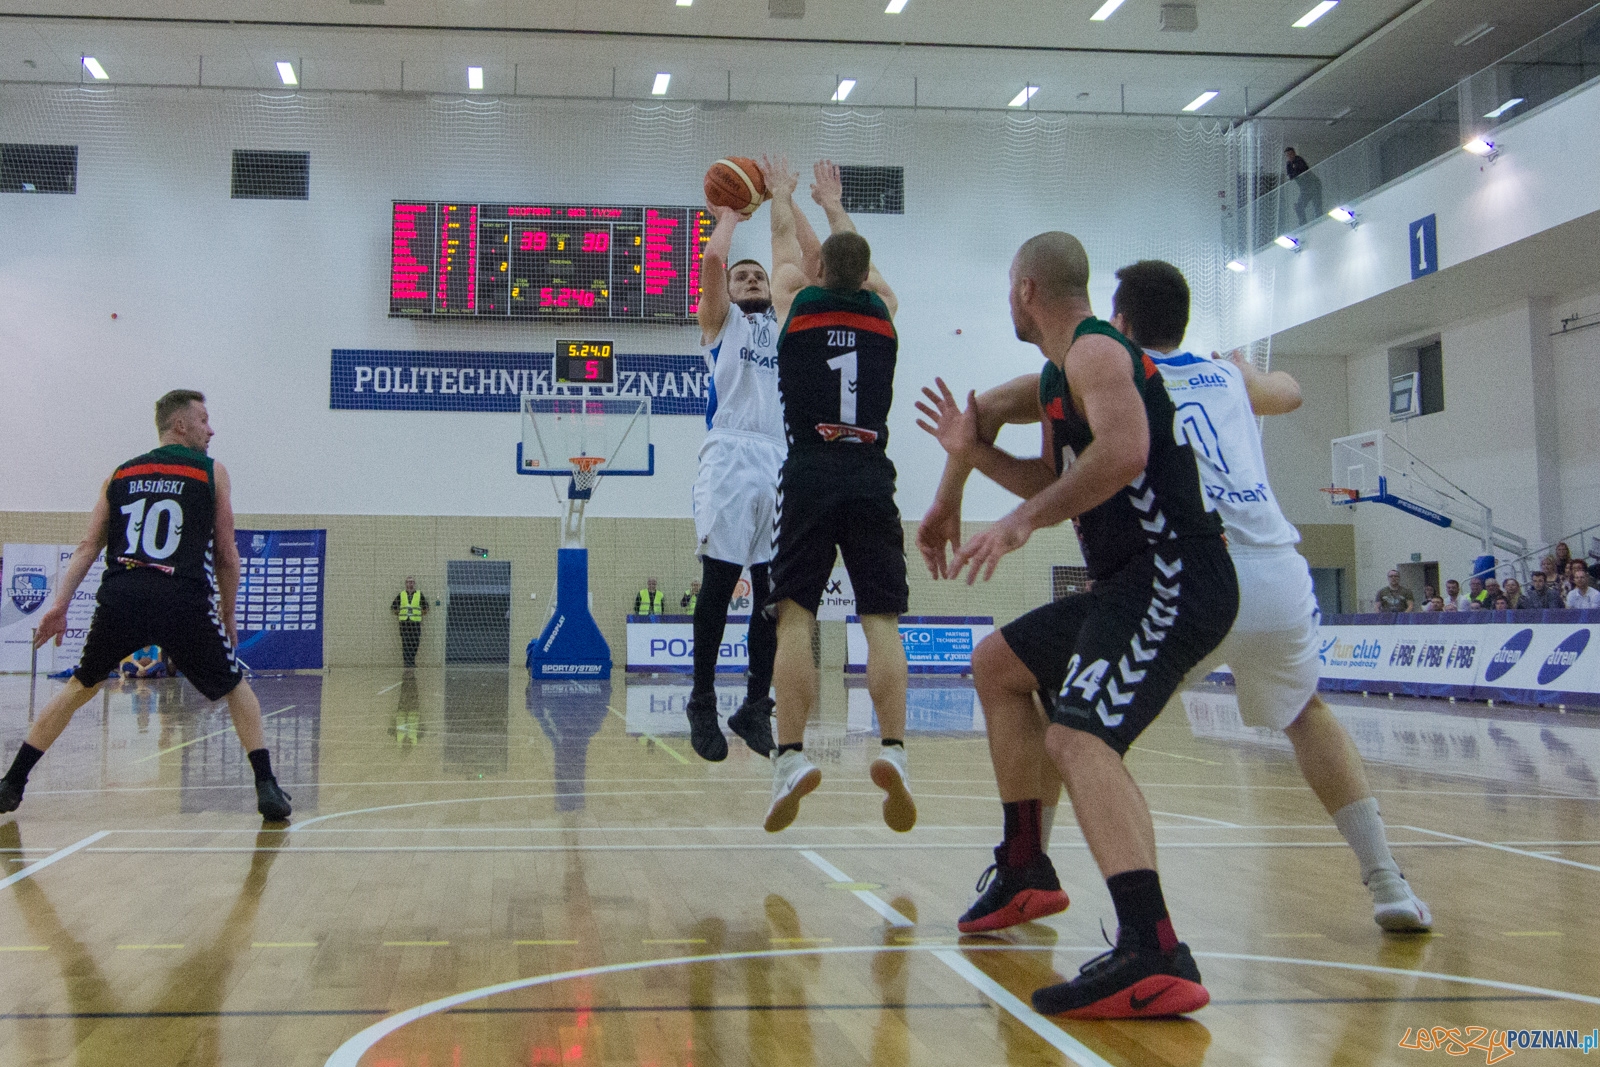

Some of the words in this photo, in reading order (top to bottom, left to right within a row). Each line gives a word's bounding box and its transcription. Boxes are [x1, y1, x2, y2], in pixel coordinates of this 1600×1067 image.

[520, 231, 548, 251] 39
[557, 241, 565, 250] 3
[581, 232, 609, 252] 30
[634, 236, 641, 246] 3
[1416, 225, 1427, 271] 1
[500, 262, 508, 271] 2
[633, 264, 641, 273] 4
[511, 287, 520, 297] 2
[601, 289, 609, 298] 4
[827, 330, 856, 347] ZUB
[585, 361, 599, 379] 5
[826, 350, 858, 425] 1
[129, 478, 185, 494] BASIŃSKI
[120, 498, 183, 560] 10
[8, 588, 50, 597] BASKET
[543, 615, 565, 652] HYDROPLAY
[1333, 638, 1381, 659] funclub
[1396, 645, 1416, 666] PBG
[1424, 645, 1445, 667] PBG
[1453, 645, 1475, 668] PBG
[1494, 647, 1521, 663] atrem
[1547, 648, 1578, 665] atrem
[542, 665, 602, 674] SPORTSYSTEM
